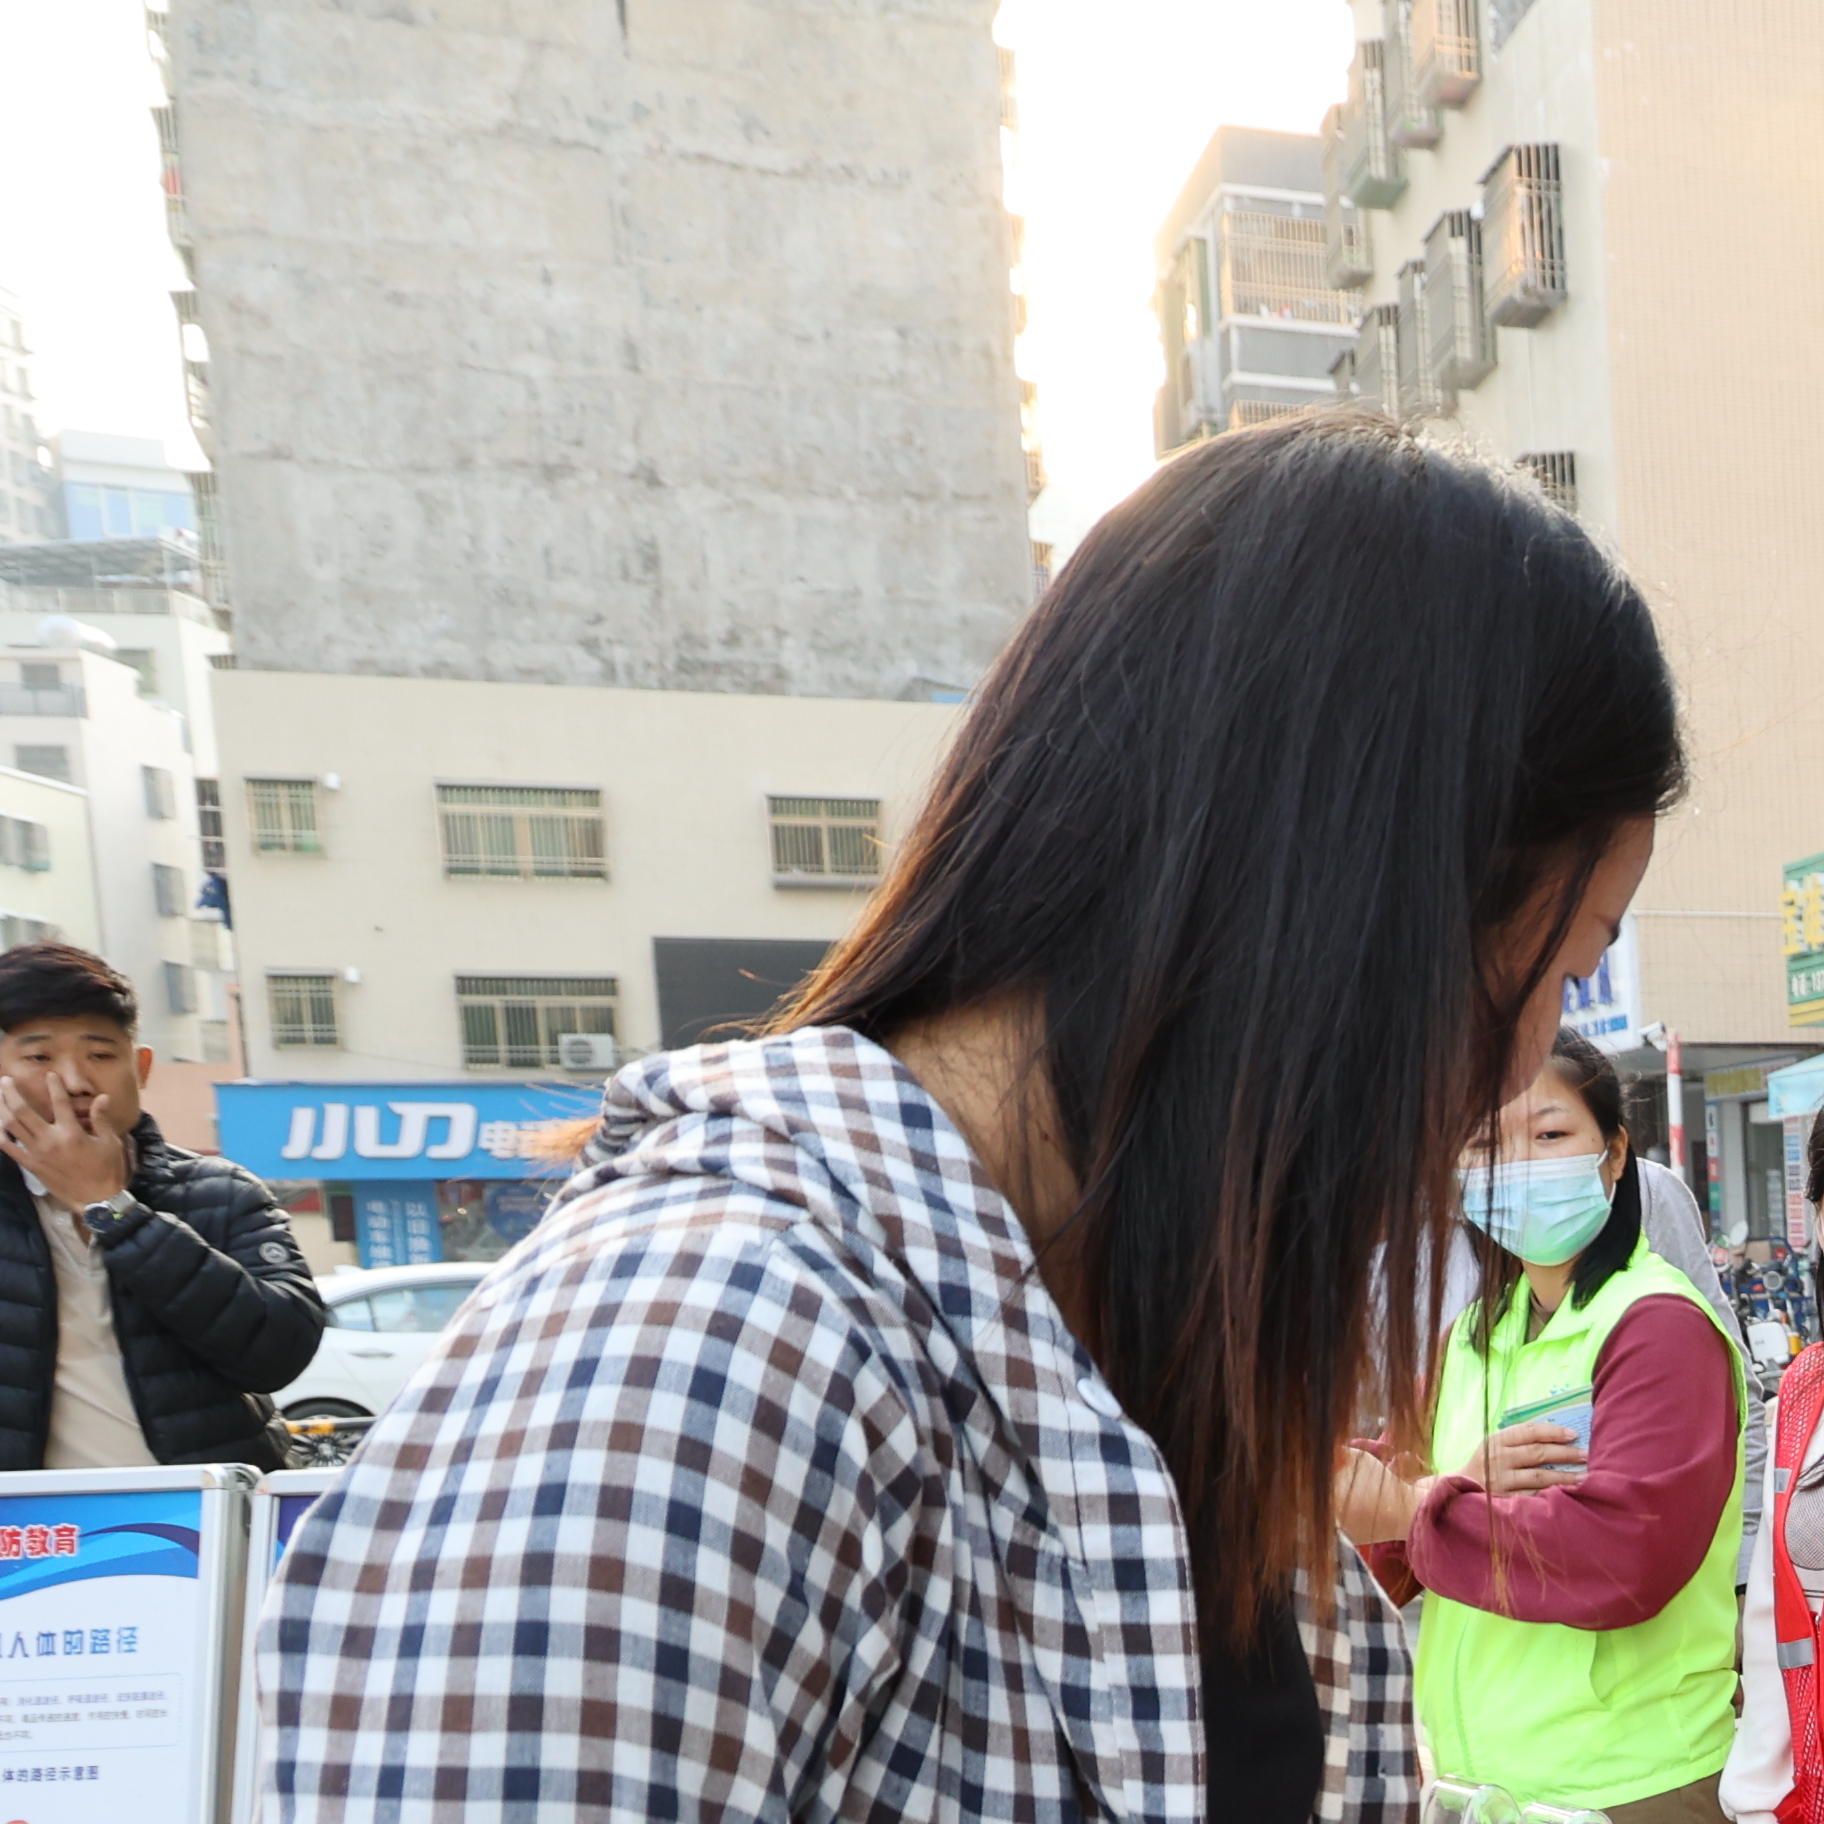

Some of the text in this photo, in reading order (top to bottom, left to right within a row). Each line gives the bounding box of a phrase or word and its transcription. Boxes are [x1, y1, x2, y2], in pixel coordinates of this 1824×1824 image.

[0, 1627, 139, 1659] 人体的路径
